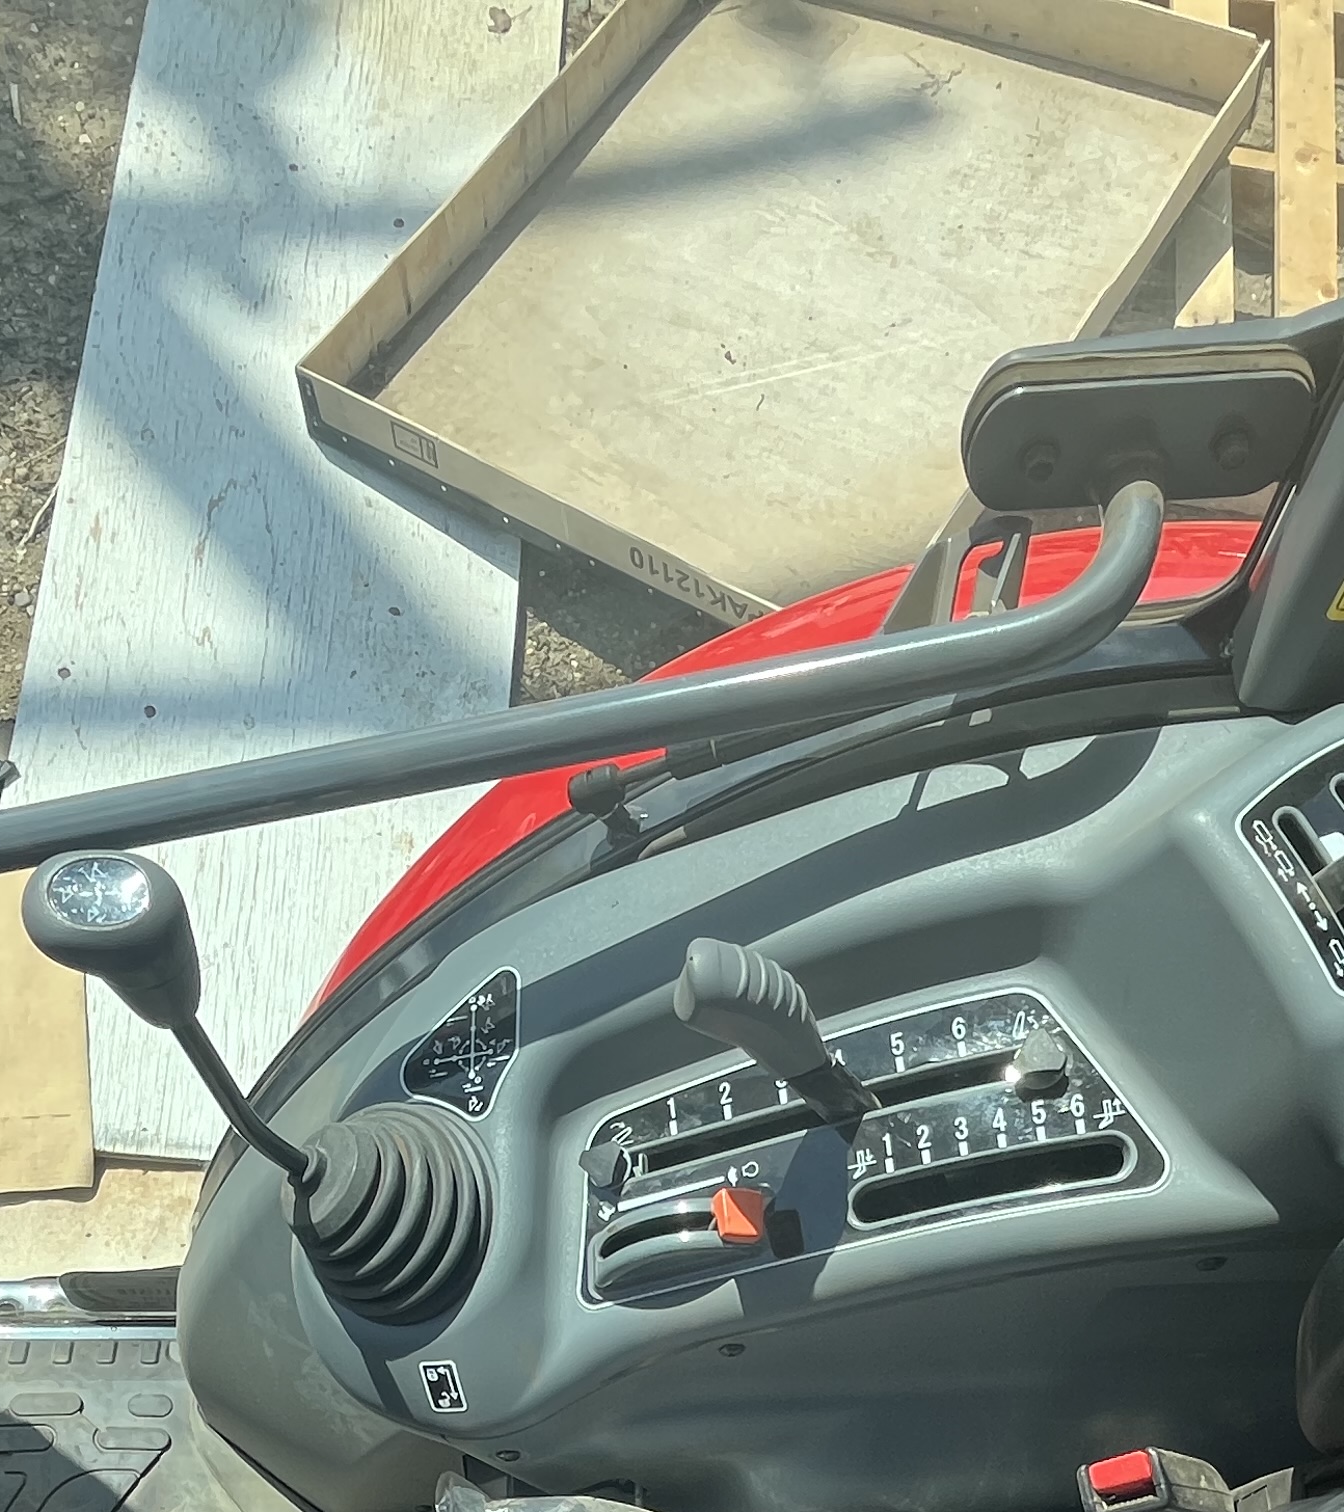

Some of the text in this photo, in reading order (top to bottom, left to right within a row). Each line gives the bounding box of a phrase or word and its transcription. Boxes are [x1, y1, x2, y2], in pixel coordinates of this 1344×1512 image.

[890, 1016, 967, 1056] 5 6
[666, 1081, 733, 1120] 1 2
[881, 1093, 1085, 1157] 1 2 3 4 5 6
